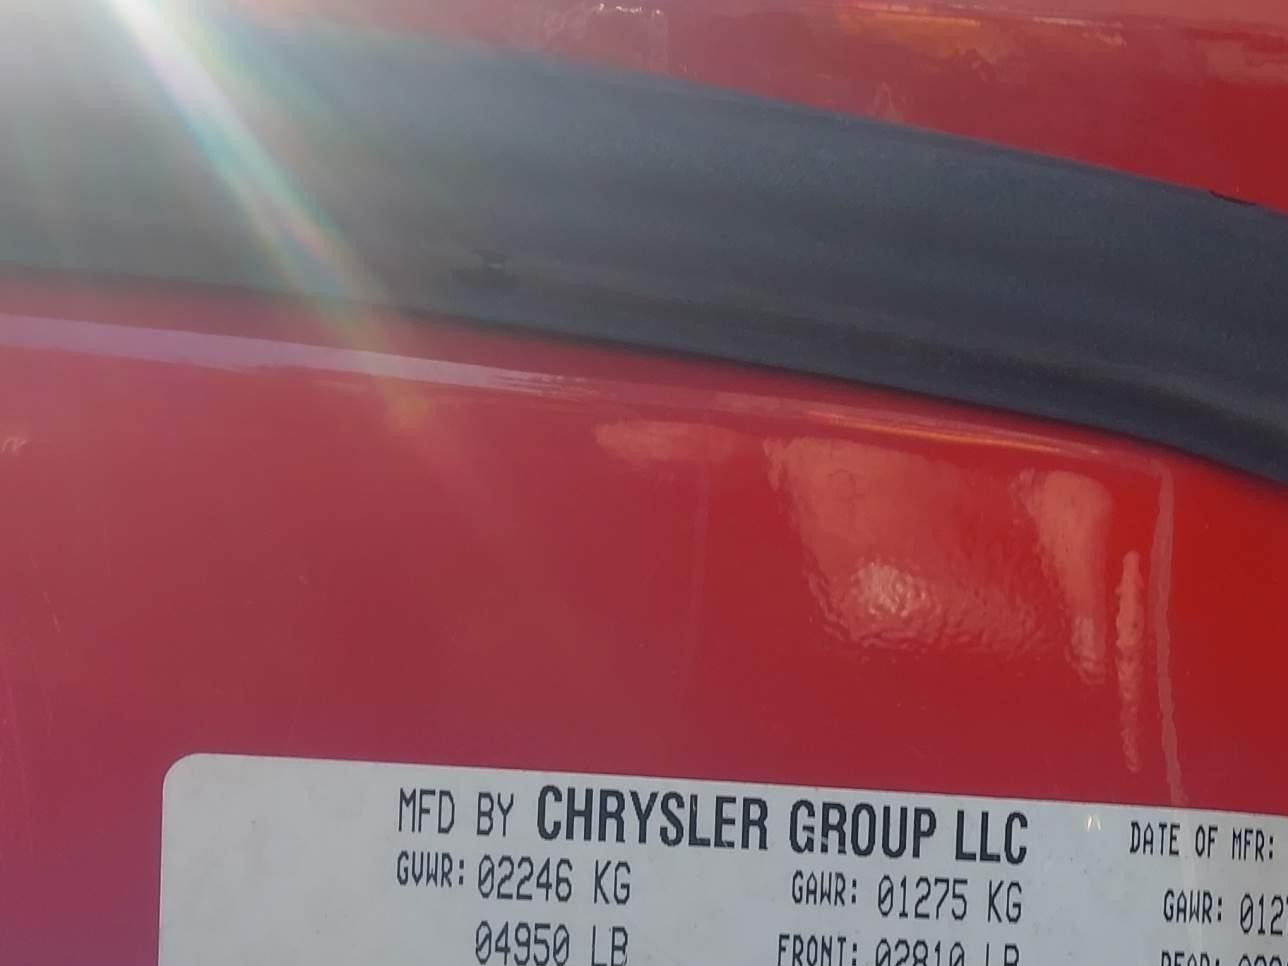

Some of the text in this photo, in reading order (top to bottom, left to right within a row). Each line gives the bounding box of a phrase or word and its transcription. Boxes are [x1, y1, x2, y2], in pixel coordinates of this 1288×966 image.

[399, 785, 1028, 865] MFD BY CHRYSLER GROUP LLC
[1130, 821, 1180, 856] DATE
[1195, 824, 1218, 859] OF
[1232, 828, 1273, 862] MFR:
[397, 850, 631, 905] GVWR: 02246 KG
[792, 870, 1022, 924] GAWR: 01275 KG
[1163, 888, 1222, 924] GAWR:
